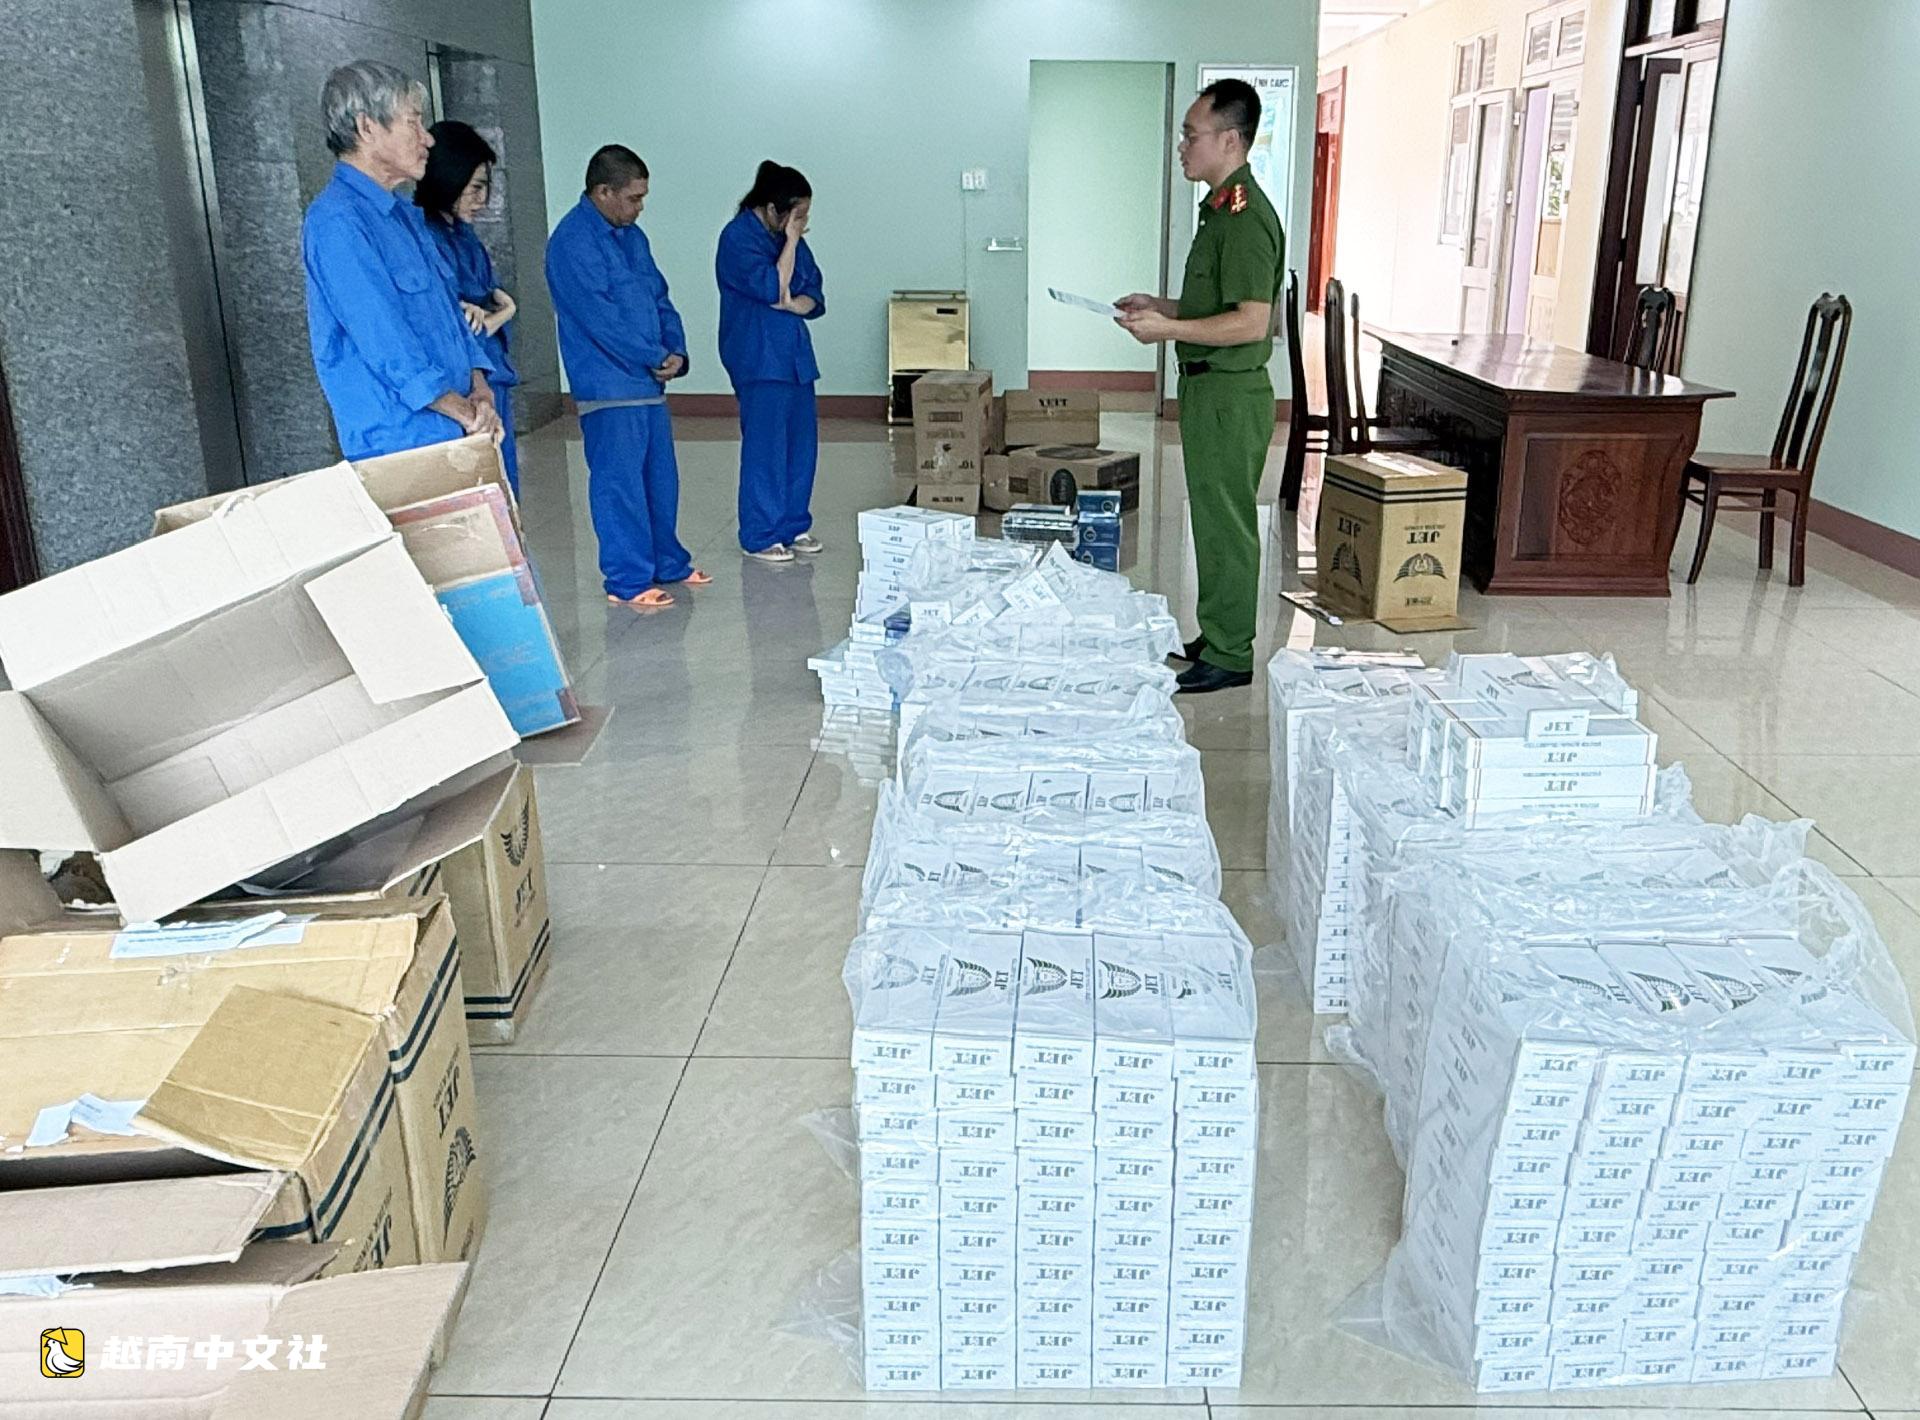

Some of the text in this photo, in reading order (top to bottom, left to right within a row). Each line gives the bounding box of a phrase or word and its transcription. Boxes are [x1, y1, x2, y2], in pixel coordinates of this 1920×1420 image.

[1337, 516, 1361, 537] JET
[1407, 531, 1440, 545] JET
[1544, 722, 1574, 732] JET
[1544, 752, 1578, 763] JET
[1544, 780, 1578, 792] JET
[516, 867, 532, 914] JET
[994, 971, 1010, 990] JET
[1070, 968, 1085, 990] JET
[1145, 974, 1160, 994] JET
[873, 1047, 911, 1059] JET
[1034, 1052, 1073, 1064] JET
[953, 1053, 991, 1065] JET
[1115, 1056, 1153, 1068] JET
[1195, 1056, 1233, 1068] JET
[1540, 1059, 1578, 1072] JET
[1856, 1060, 1894, 1071] JET
[1626, 1070, 1665, 1081] JET
[1707, 1069, 1747, 1081] JET
[1783, 1067, 1821, 1079] JET
[878, 1082, 915, 1094] JET
[1035, 1087, 1074, 1099] JET
[957, 1088, 995, 1100] JET
[1116, 1091, 1155, 1104] JET
[1198, 1091, 1236, 1103] JET
[439, 1065, 459, 1139] JET
[1531, 1095, 1569, 1107] JET
[1848, 1099, 1886, 1110] JET
[1617, 1103, 1655, 1115] JET
[1698, 1106, 1736, 1117] JET
[1773, 1103, 1812, 1115] JET
[880, 1118, 919, 1130] JET
[958, 1126, 996, 1138] JET
[1038, 1126, 1074, 1138] JET
[1115, 1126, 1153, 1138] JET
[1198, 1126, 1235, 1137] JET
[1522, 1129, 1560, 1141] JET
[1605, 1136, 1643, 1147] JET
[1686, 1139, 1723, 1150] JET
[1763, 1138, 1800, 1149] JET
[1839, 1134, 1876, 1145] JET
[882, 1158, 920, 1169] JET
[1197, 1163, 1234, 1174] JET
[1513, 1162, 1550, 1173] JET
[960, 1166, 997, 1177] JET
[1037, 1166, 1075, 1177] JET
[1116, 1164, 1153, 1176] JET
[1595, 1168, 1632, 1179] JET
[1751, 1168, 1787, 1179] JET
[1826, 1166, 1863, 1177] JET
[1675, 1172, 1712, 1182] JET
[883, 1197, 920, 1209] JET
[961, 1202, 997, 1213] JET
[1038, 1201, 1075, 1212] JET
[1115, 1200, 1153, 1212] JET
[1195, 1199, 1232, 1210] JET
[1510, 1199, 1547, 1209] JET
[1586, 1198, 1623, 1209] JET
[1664, 1200, 1700, 1211] JET
[1740, 1199, 1776, 1209] JET
[1817, 1200, 1854, 1210] JET
[882, 1233, 919, 1245] JET
[1503, 1233, 1539, 1243] JET
[1579, 1231, 1616, 1242] JET
[1652, 1228, 1689, 1240] JET
[1727, 1228, 1764, 1239] JET
[1807, 1231, 1843, 1242] JET
[959, 1236, 996, 1247] JET
[1037, 1235, 1073, 1246] JET
[1115, 1234, 1152, 1246] JET
[1194, 1234, 1230, 1245] JET
[1647, 1264, 1683, 1274] JET
[1723, 1264, 1758, 1274] JET
[1794, 1260, 1831, 1271] JET
[883, 1268, 919, 1279] JET
[960, 1269, 996, 1281] JET
[1037, 1268, 1073, 1280] JET
[1114, 1268, 1150, 1280] JET
[1191, 1268, 1228, 1278] JET
[1499, 1268, 1536, 1278] JET
[1577, 1270, 1613, 1280] JET
[1643, 1298, 1679, 1308] JET
[1789, 1293, 1825, 1303] JET
[884, 1301, 920, 1311] JET
[960, 1303, 996, 1313] JET
[1037, 1302, 1073, 1312] JET
[1113, 1302, 1149, 1312] JET
[1190, 1301, 1226, 1311] JET
[1497, 1302, 1533, 1313] JET
[1573, 1303, 1609, 1313] JET
[1719, 1301, 1755, 1310] JET
[1784, 1325, 1820, 1335] JET
[886, 1335, 921, 1344] JET
[961, 1336, 997, 1346] JET
[1036, 1336, 1072, 1346] JET
[1113, 1335, 1148, 1345] JET
[1188, 1334, 1224, 1344] JET
[1498, 1337, 1533, 1347] JET
[1571, 1335, 1606, 1345] JET
[1641, 1332, 1676, 1342] JET
[1715, 1332, 1750, 1342] JET
[1712, 1361, 1746, 1371] JET
[1783, 1357, 1817, 1369] JET
[962, 1370, 997, 1379] JET
[1036, 1369, 1072, 1378] JET
[1112, 1368, 1147, 1378] JET
[1187, 1368, 1222, 1377] JET
[1572, 1368, 1606, 1378] JET
[1641, 1364, 1676, 1374] JET
[886, 1371, 922, 1380] JET
[1500, 1371, 1535, 1381] JET
